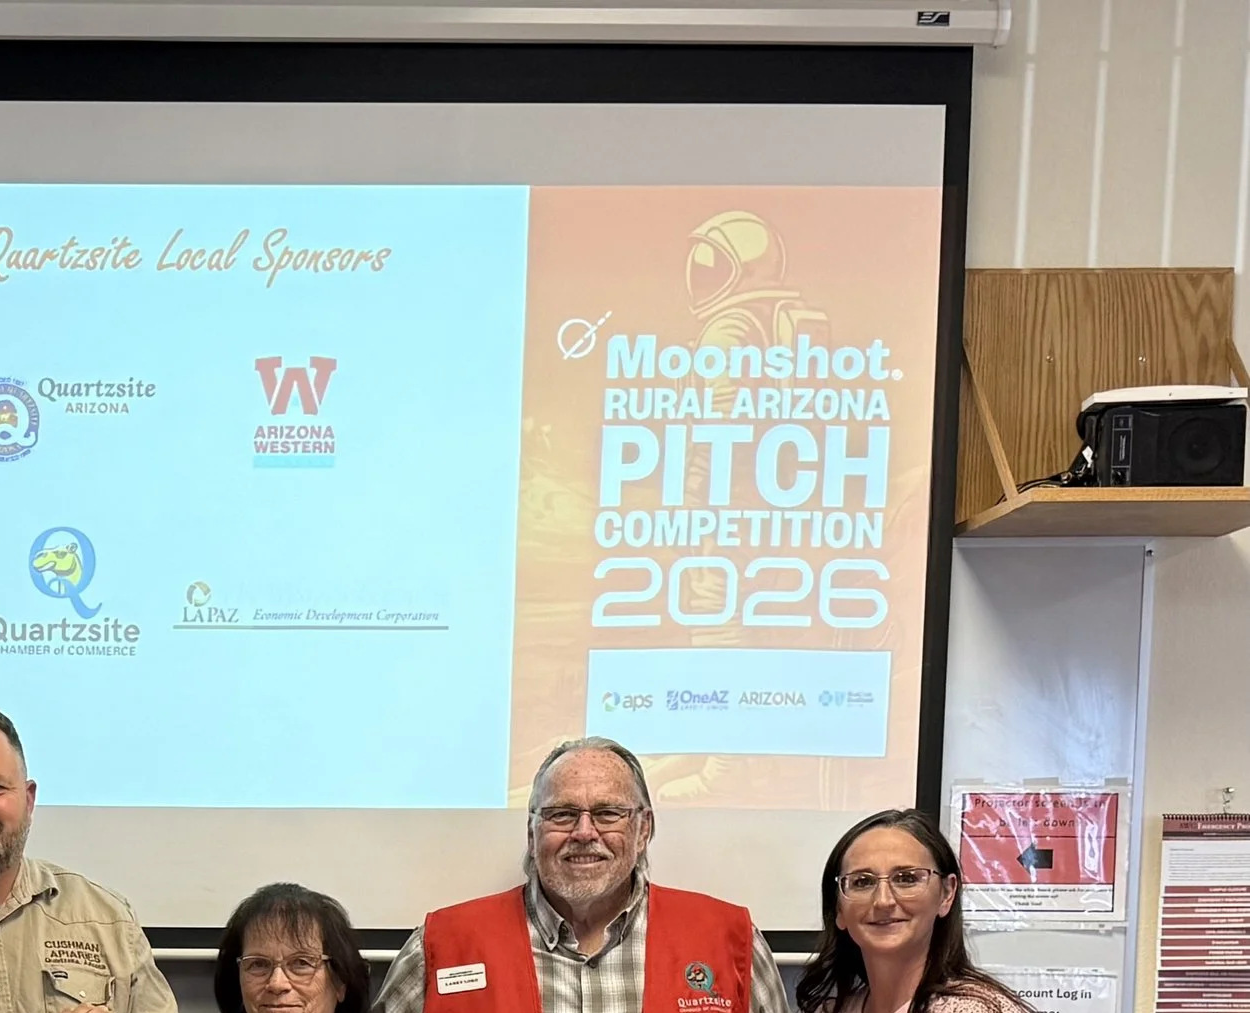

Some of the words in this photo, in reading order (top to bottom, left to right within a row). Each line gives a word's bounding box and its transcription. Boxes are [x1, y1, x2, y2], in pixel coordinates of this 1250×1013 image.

[155, 228, 251, 271] Local
[253, 227, 392, 289] Sponsors
[37, 377, 156, 402] Quartzsite
[65, 402, 130, 414] ARIZONA
[604, 388, 723, 420] RURAL
[731, 388, 891, 421] ARIZONA
[253, 425, 335, 440] ARIZONA
[253, 440, 335, 454] WESTERN
[599, 424, 891, 508] PITCH
[594, 510, 884, 549] COMPETITION
[591, 557, 890, 628] 2026
[252, 608, 303, 621] Economic
[305, 608, 373, 624] Development
[376, 608, 439, 624] Corporation
[53, 645, 65, 655] of
[67, 645, 136, 656] COMMERCE
[622, 693, 654, 712] aps
[680, 690, 730, 704] OneAZ
[738, 691, 807, 706] ARIZONA
[44, 940, 100, 952] CUSHMAN
[50, 950, 101, 963] APIARIES
[1014, 989, 1053, 999] count
[1056, 988, 1078, 1001] Log
[1080, 989, 1092, 999] in
